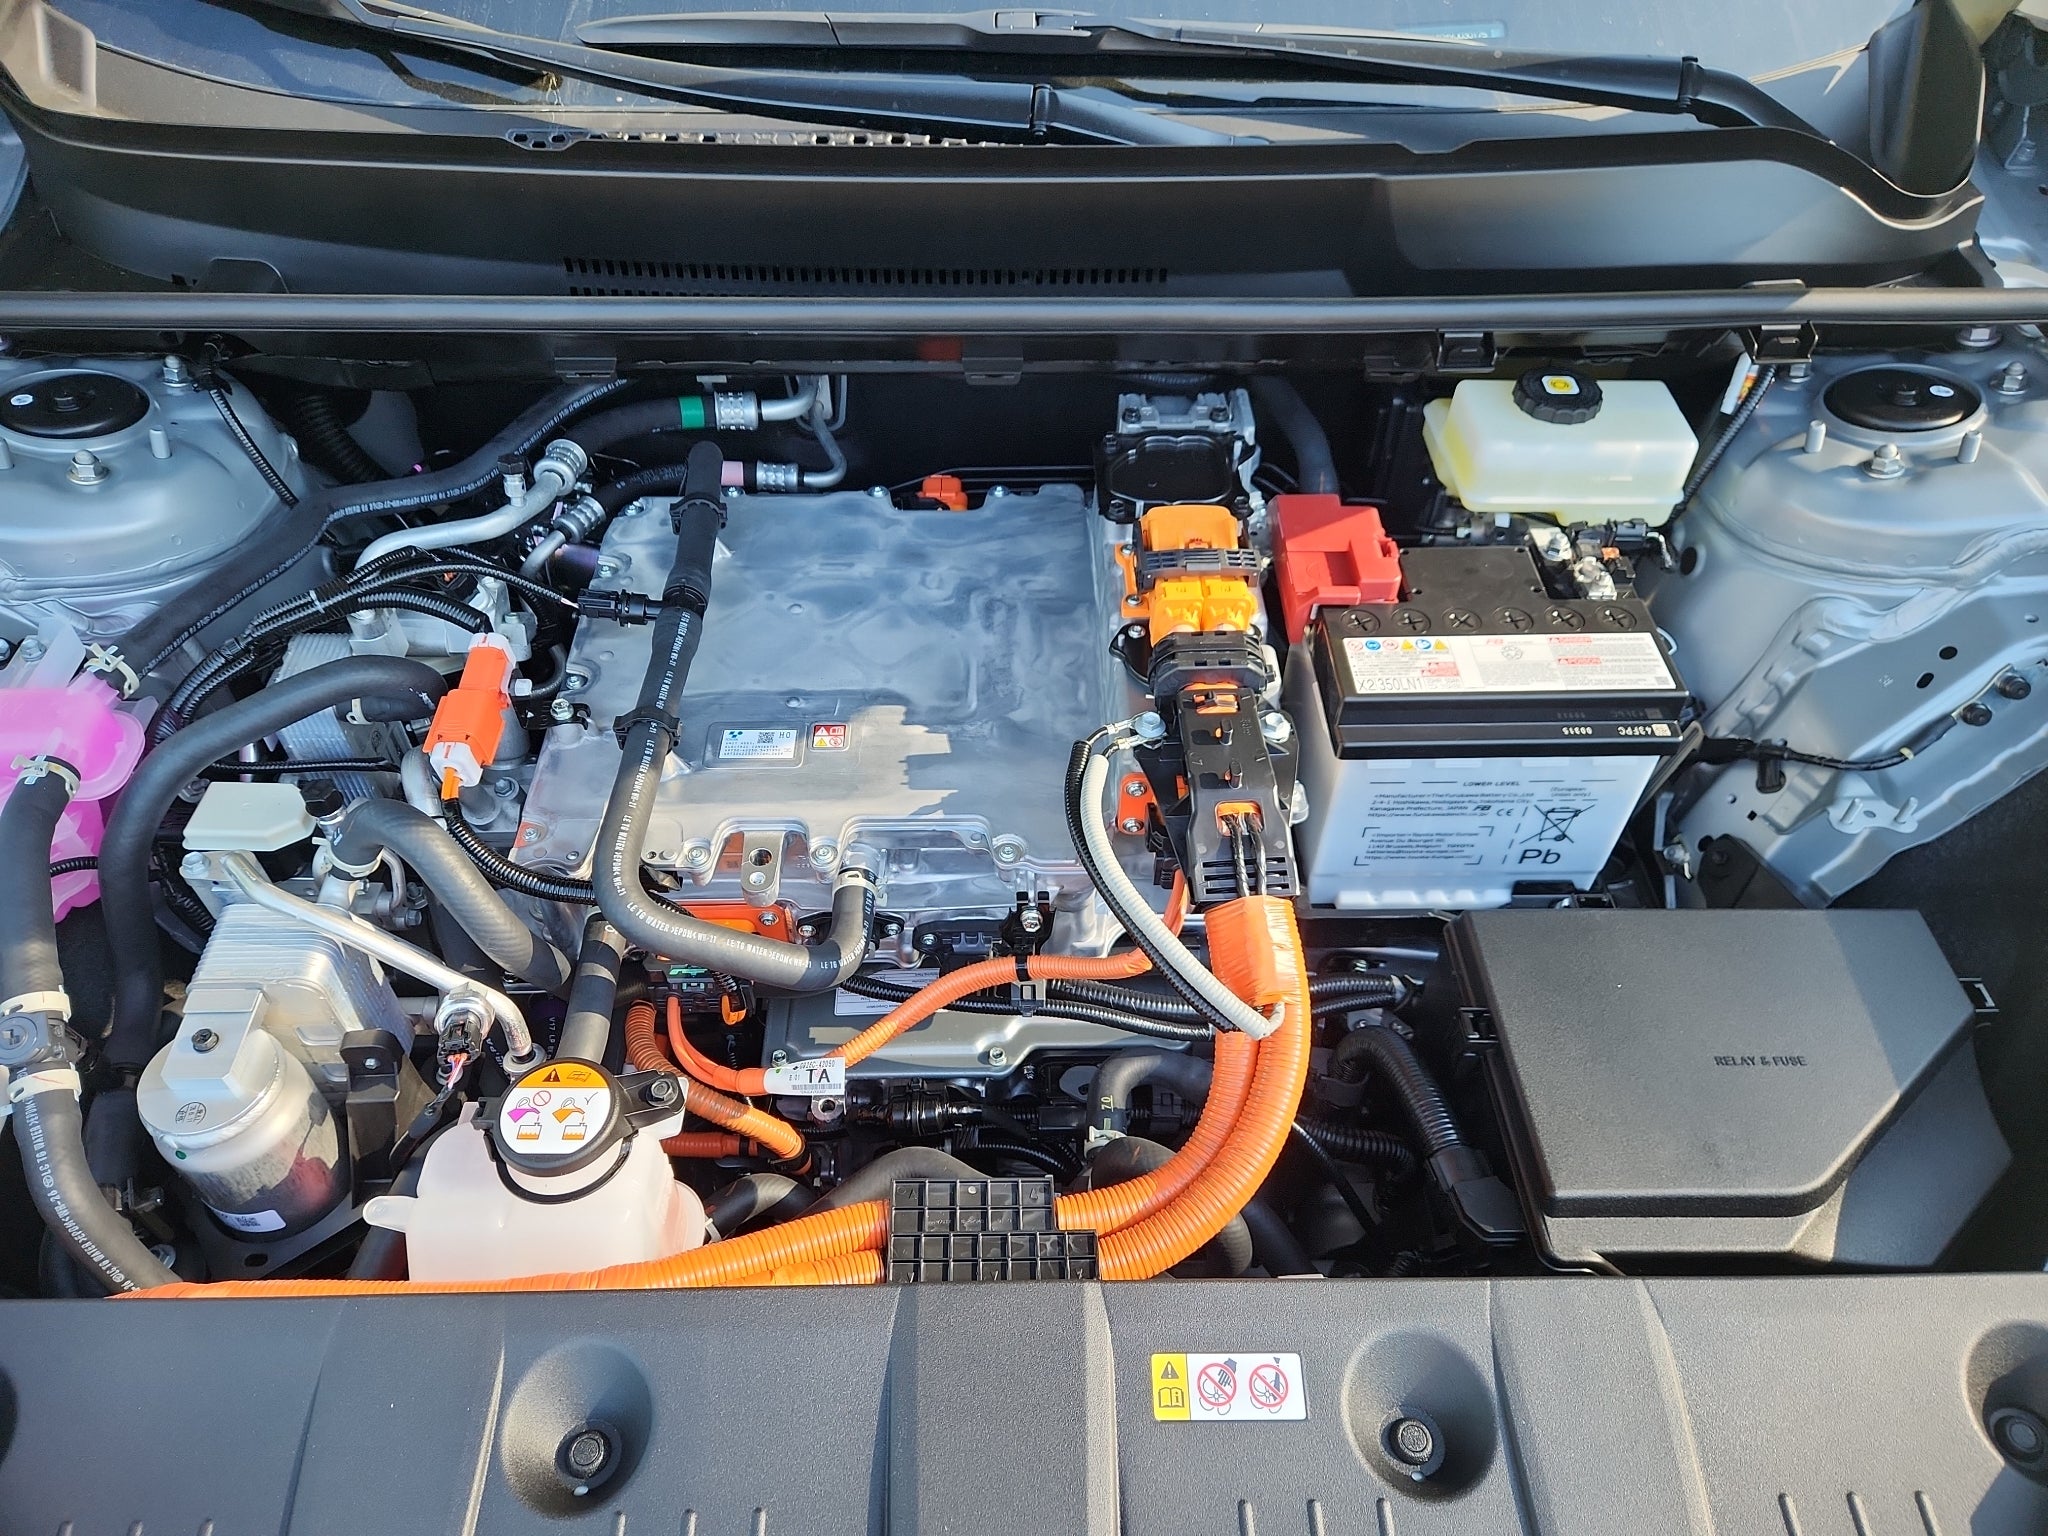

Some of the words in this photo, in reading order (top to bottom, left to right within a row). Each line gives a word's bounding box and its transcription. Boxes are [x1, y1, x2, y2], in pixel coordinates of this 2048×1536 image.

[639, 755, 651, 773] WATER
[615, 832, 628, 850] WATER
[1518, 849, 1561, 864] Pb
[626, 902, 637, 912] LE
[645, 915, 669, 932] WATER
[746, 943, 768, 957] WATER
[838, 952, 855, 967] WATER
[1714, 1056, 1756, 1066] RELAY
[1760, 1056, 1770, 1066] &
[1772, 1056, 1808, 1066] FUSE
[806, 1068, 830, 1083] TA
[1101, 1096, 1111, 1110] 70
[28, 1124, 46, 1150] WATER
[80, 1238, 104, 1264] WATER
